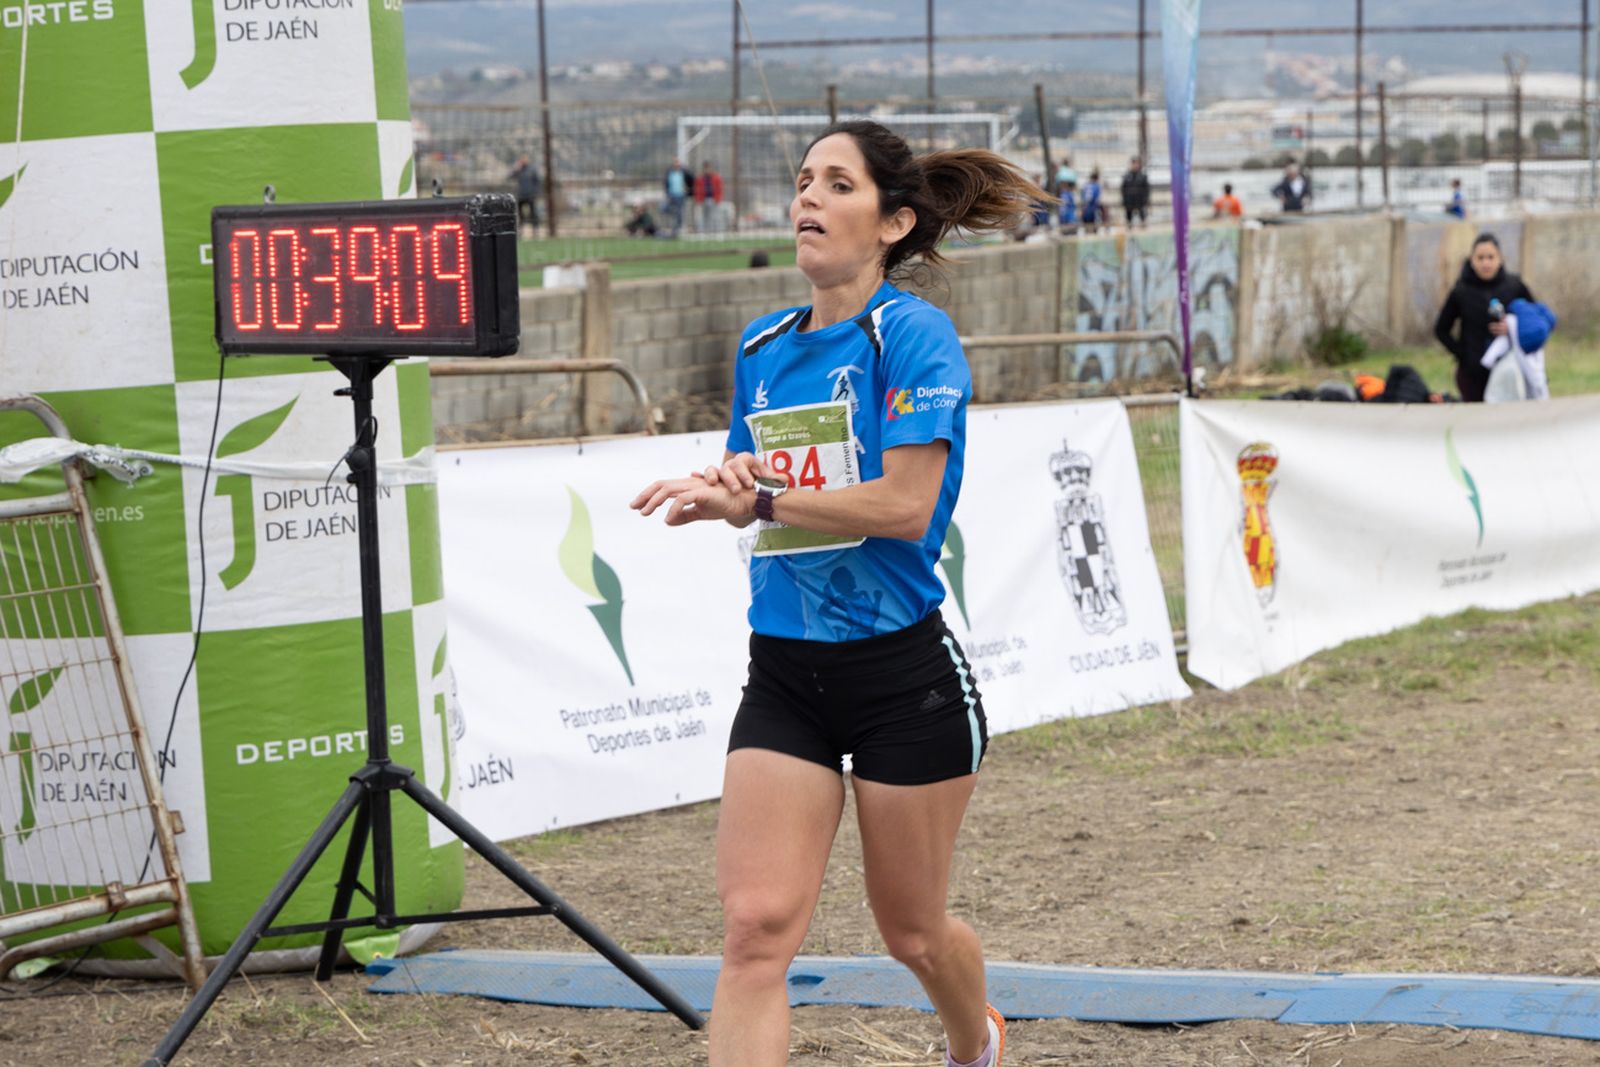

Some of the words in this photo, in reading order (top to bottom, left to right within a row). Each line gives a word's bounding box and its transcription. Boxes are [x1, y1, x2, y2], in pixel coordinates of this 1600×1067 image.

[0, 0, 114, 28] ORTES
[226, 21, 259, 42] DE
[264, 16, 318, 40] JAÉN
[0, 247, 139, 279] DIPUTACIÓN
[230, 223, 470, 331] 00:39:09
[3, 287, 29, 309] DE
[33, 281, 89, 307] JAÉN
[916, 401, 930, 412] de
[763, 446, 826, 490] 84
[263, 485, 391, 511] DIPUTACN
[265, 520, 298, 542] DE
[303, 512, 356, 538] JAÉN
[559, 703, 627, 729] Patronato
[628, 689, 694, 716] Municipal
[695, 687, 712, 707] de
[236, 724, 404, 765] DEPORTS
[587, 727, 652, 757] Deportes
[653, 723, 672, 743] de
[674, 716, 707, 740] Jaén
[39, 749, 177, 772] DIPUTACIN
[466, 752, 515, 789] JAÉN
[41, 782, 67, 803] DE
[70, 778, 127, 803] JAÉN
